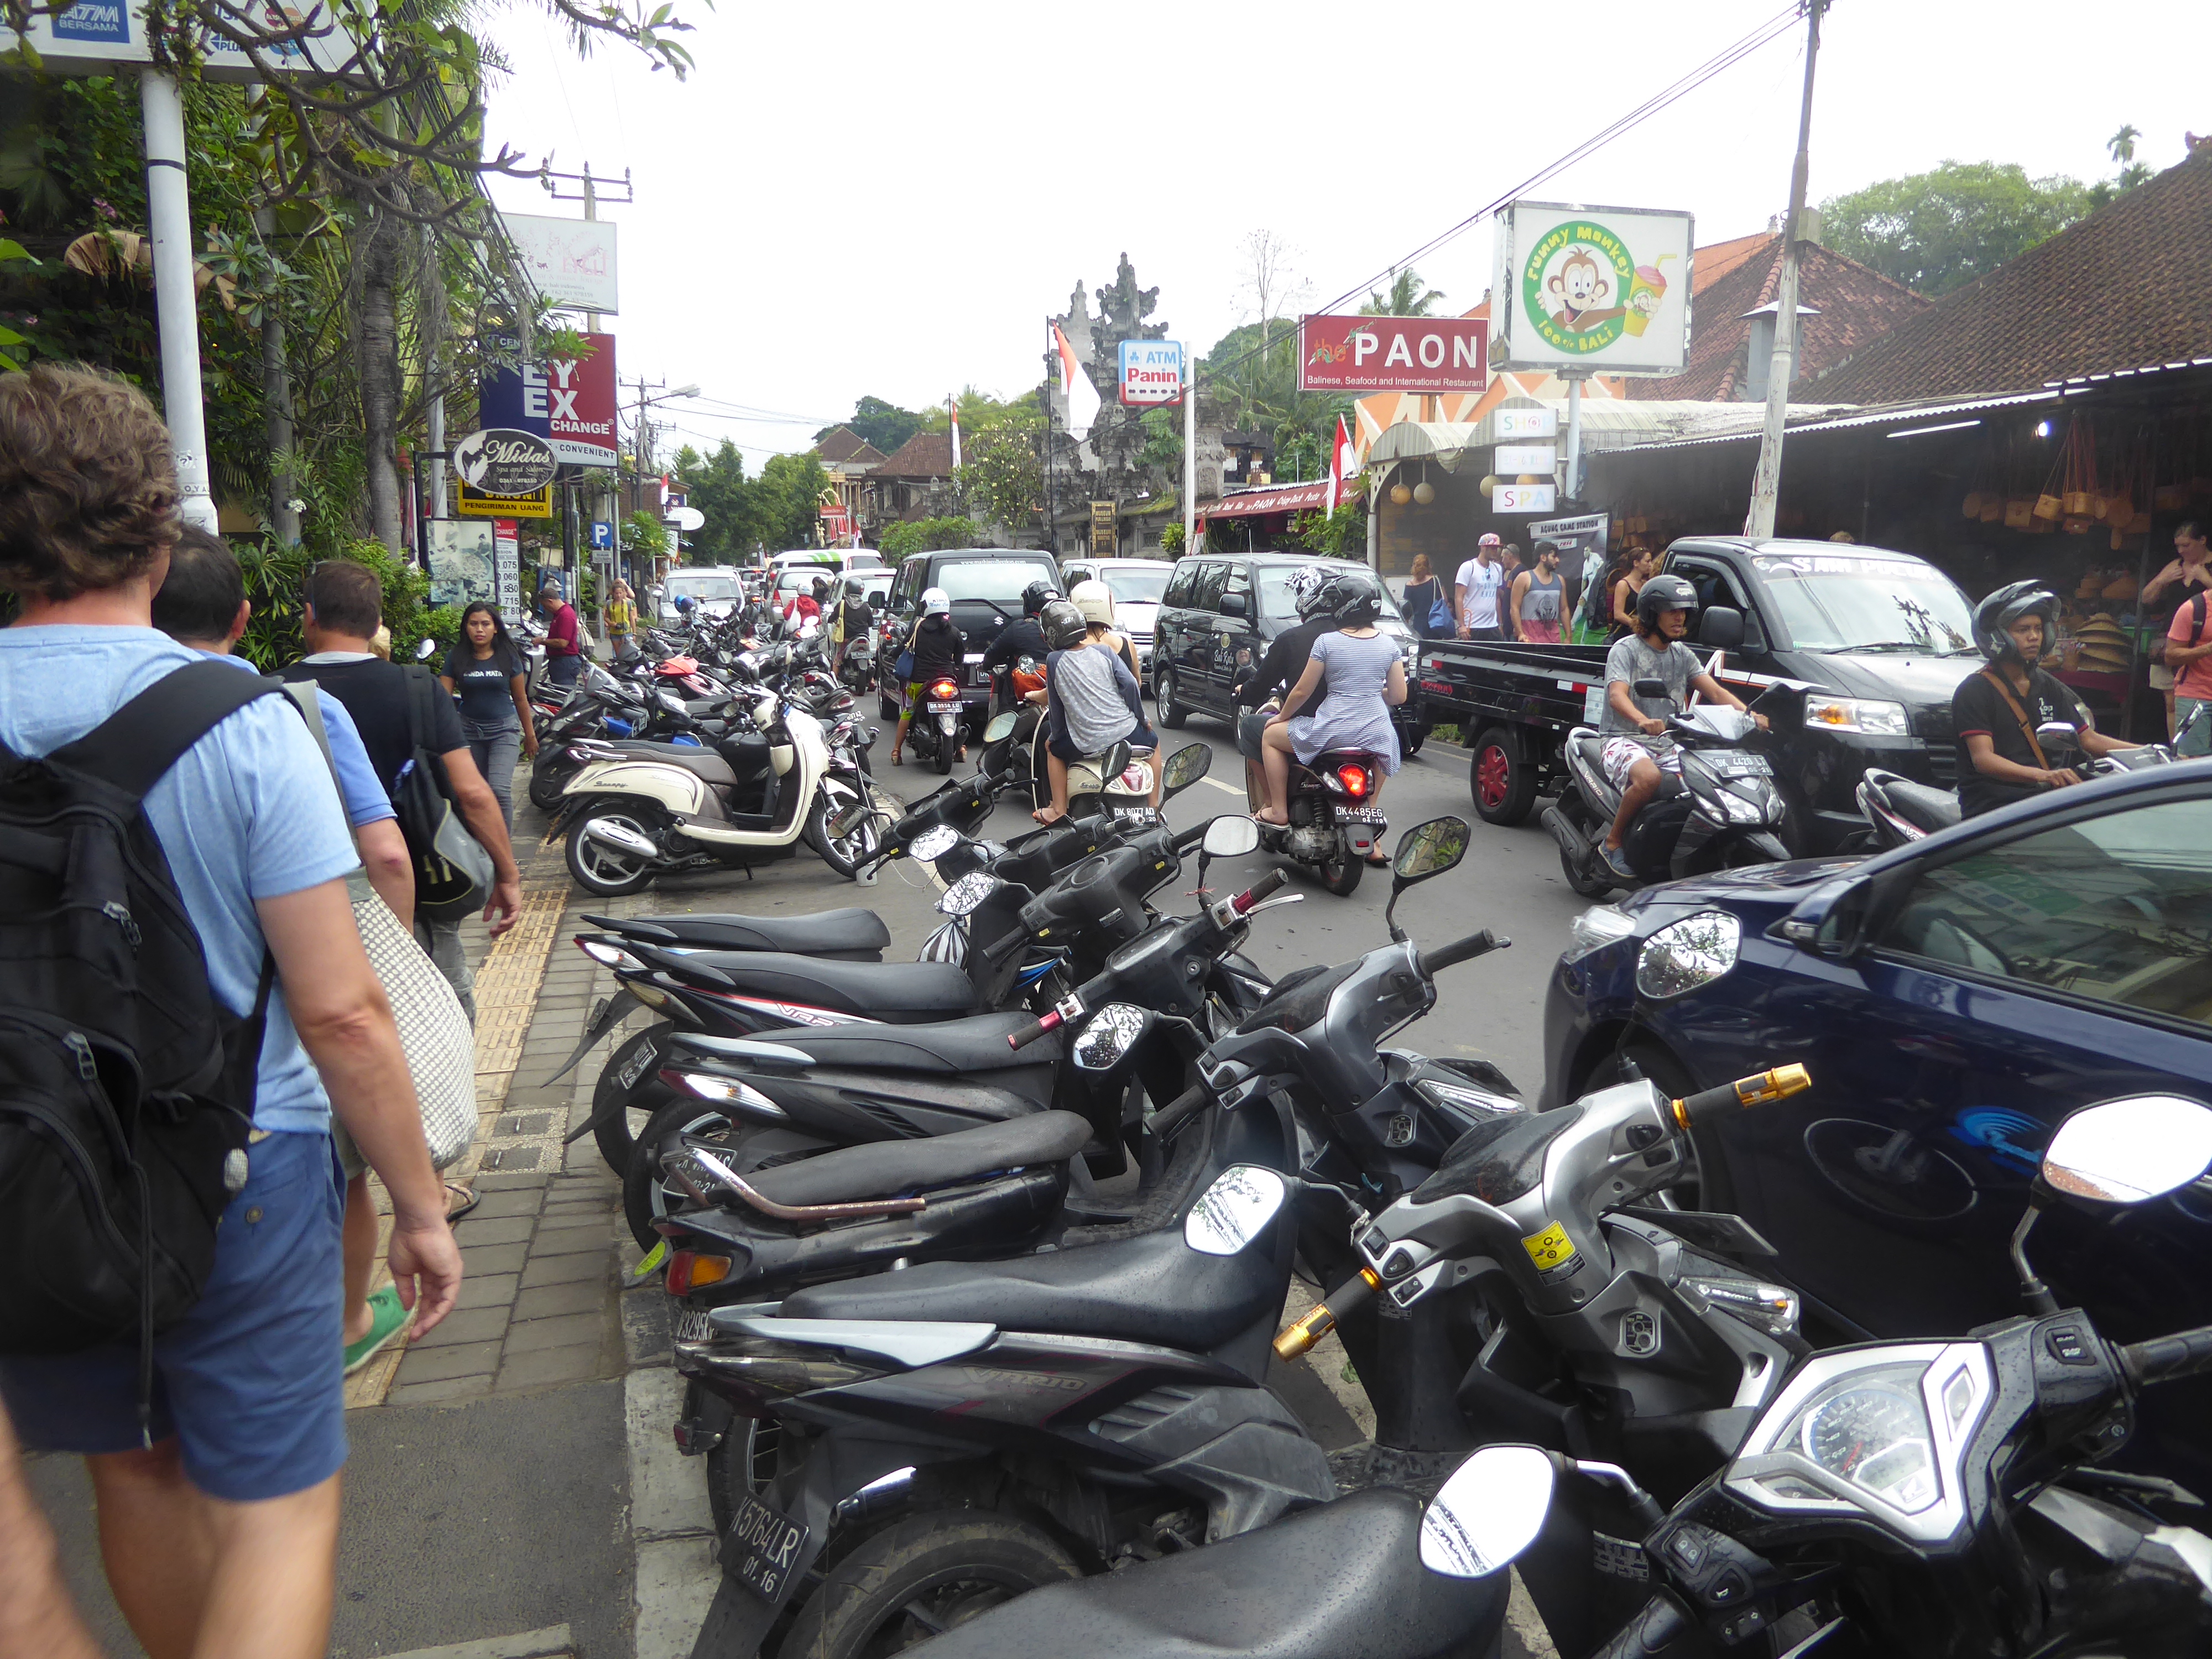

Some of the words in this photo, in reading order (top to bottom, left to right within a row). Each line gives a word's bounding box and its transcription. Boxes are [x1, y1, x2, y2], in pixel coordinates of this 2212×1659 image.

[59, 19, 119, 32] BERSAMA
[1313, 338, 1346, 362] the
[1355, 333, 1477, 368] PAON
[1146, 351, 1177, 364] ATM
[1128, 368, 1177, 382] Panin
[1307, 375, 1343, 385] Balinese,
[1345, 376, 1376, 385] Seafood
[1379, 378, 1393, 386] and
[1395, 377, 1441, 387] International
[1443, 378, 1484, 387] Restaurant
[550, 420, 611, 435] CHANGE
[486, 440, 550, 463] Midas
[560, 444, 615, 459] CONVENIENT
[497, 466, 508, 474] Spa
[1504, 491, 1546, 507] SPA
[465, 502, 517, 510] PENGIRIMAN
[1559, 523, 1575, 532] GAME
[1576, 519, 1599, 530] STATION
[594, 524, 608, 544] P
[504, 597, 519, 605] 715
[1714, 759, 1729, 768] DK
[1114, 807, 1126, 816] DK
[775, 1002, 840, 1027] VAR
